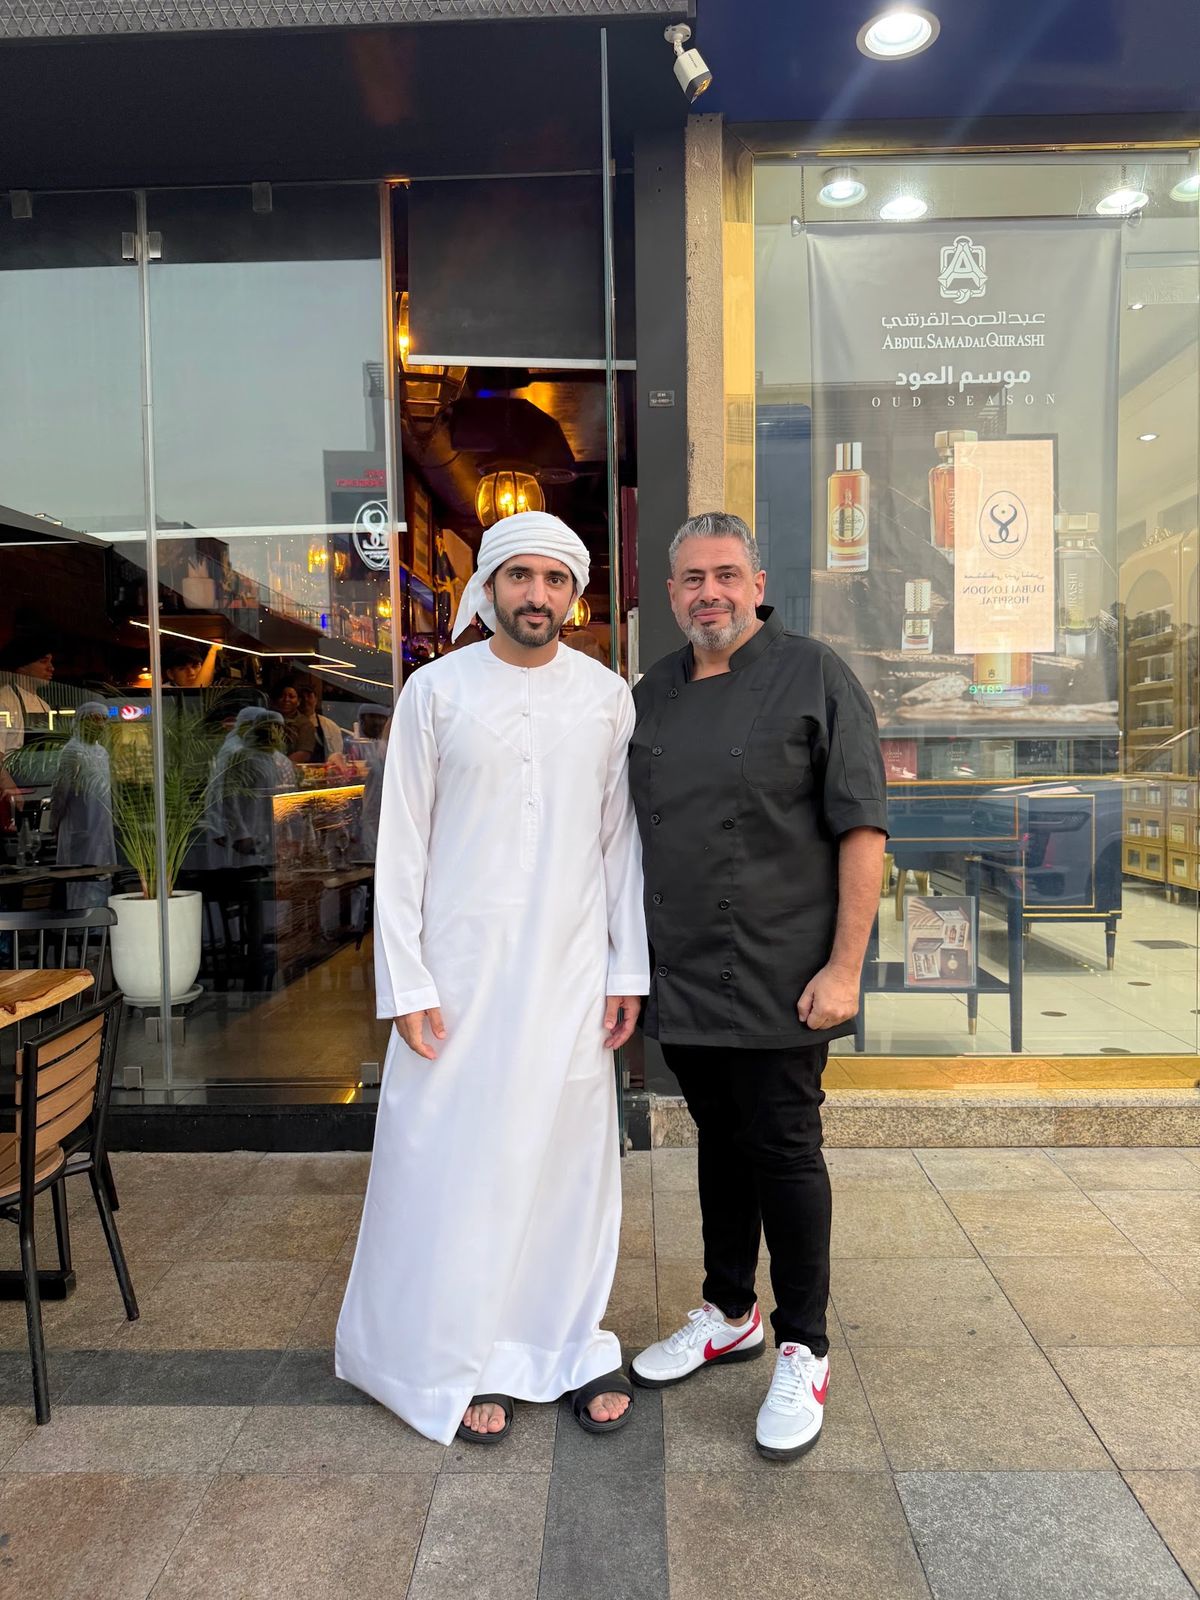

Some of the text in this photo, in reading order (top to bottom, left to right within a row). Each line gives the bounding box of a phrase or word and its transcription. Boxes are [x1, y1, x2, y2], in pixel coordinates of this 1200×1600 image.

[881, 311, 1045, 329] عبد الصمد القرشي
[895, 365, 1031, 393] موسم العود
[871, 393, 1056, 408] OUD SEASON
